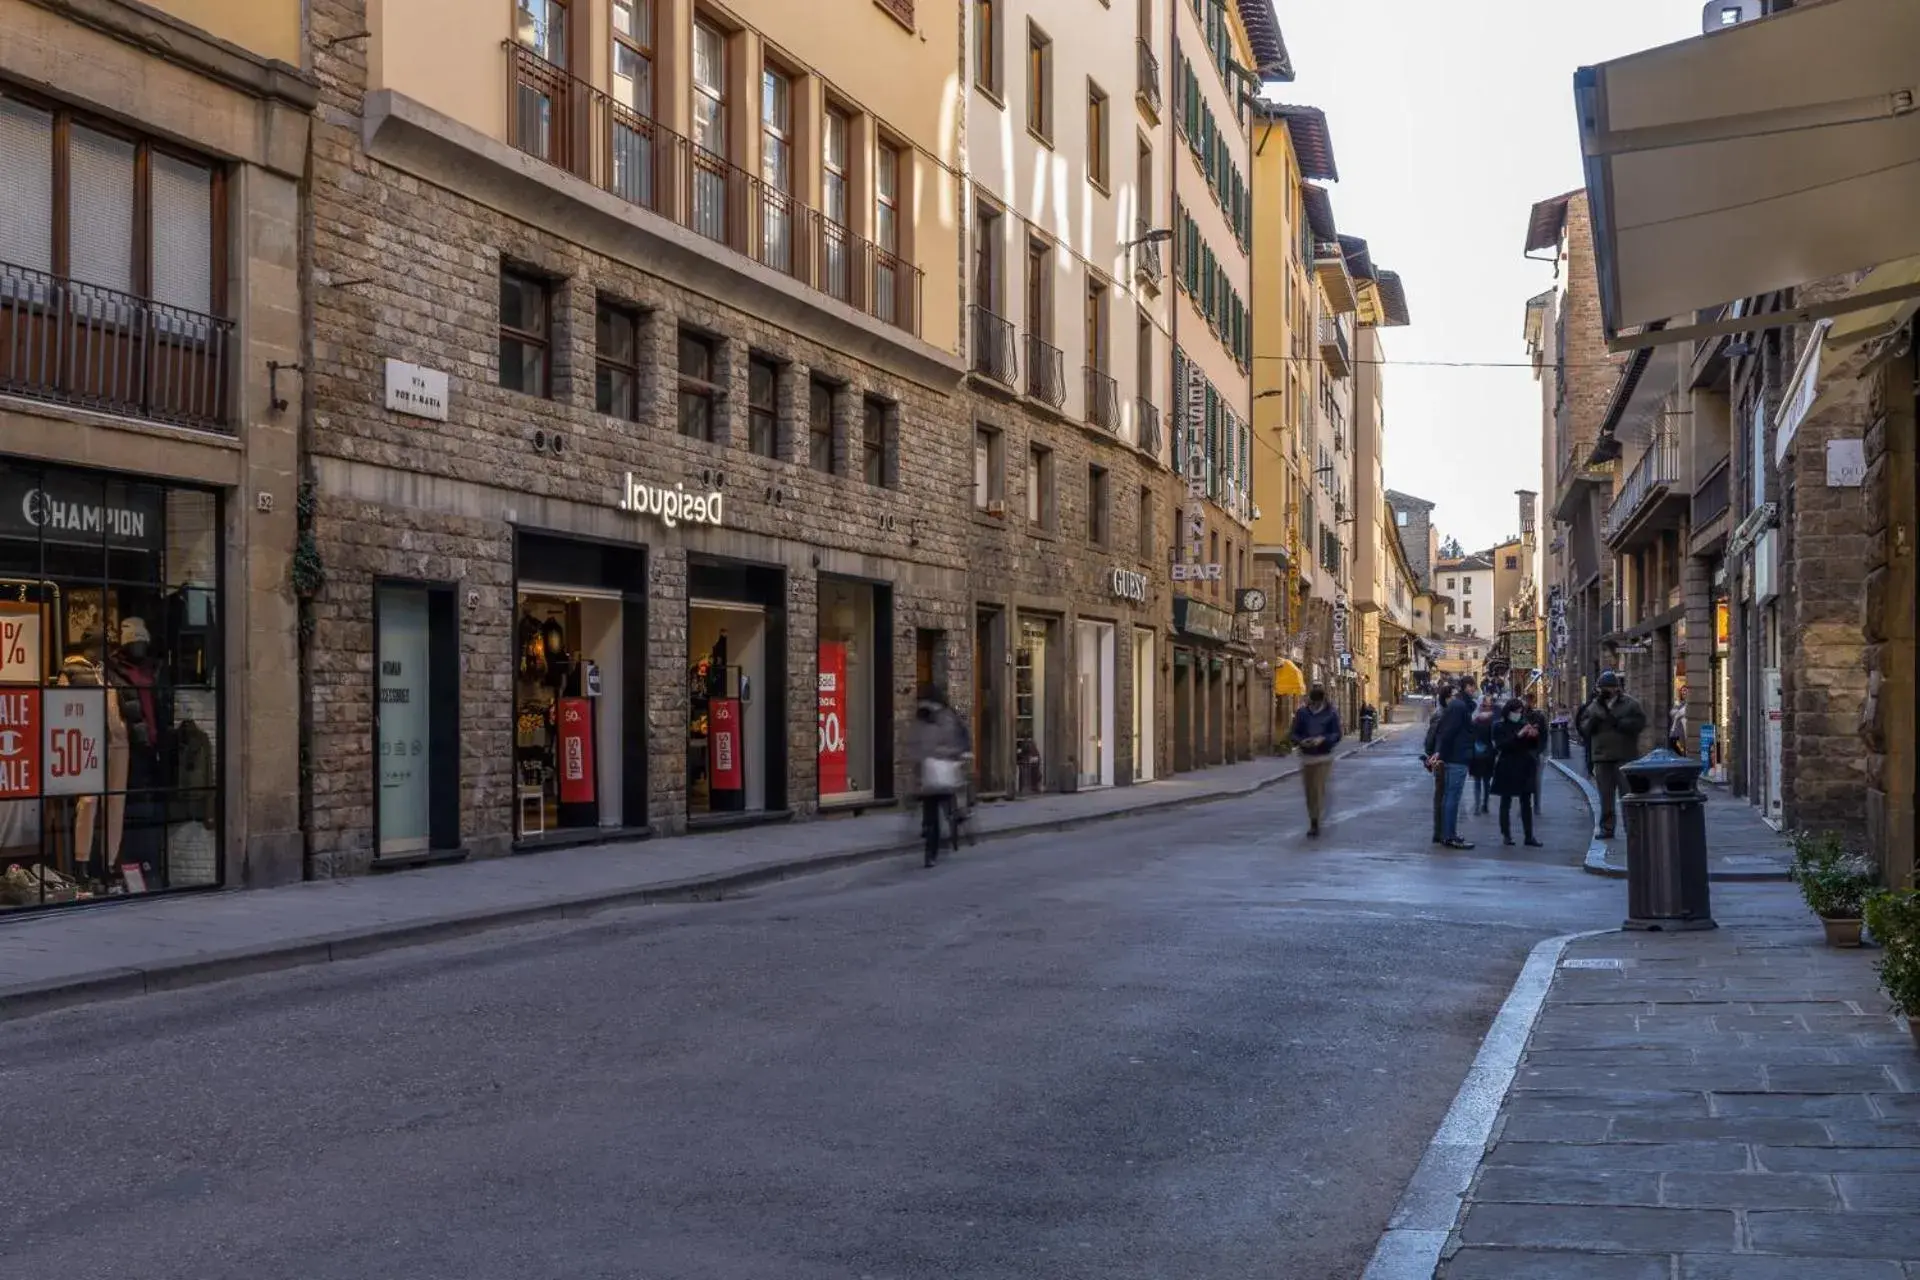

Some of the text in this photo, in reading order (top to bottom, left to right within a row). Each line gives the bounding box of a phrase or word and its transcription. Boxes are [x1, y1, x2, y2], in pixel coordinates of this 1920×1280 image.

[412, 377, 425, 387] VIA
[1114, 568, 1147, 602] GUESS
[1172, 563, 1222, 581] BAR
[50, 728, 99, 778] 50%
